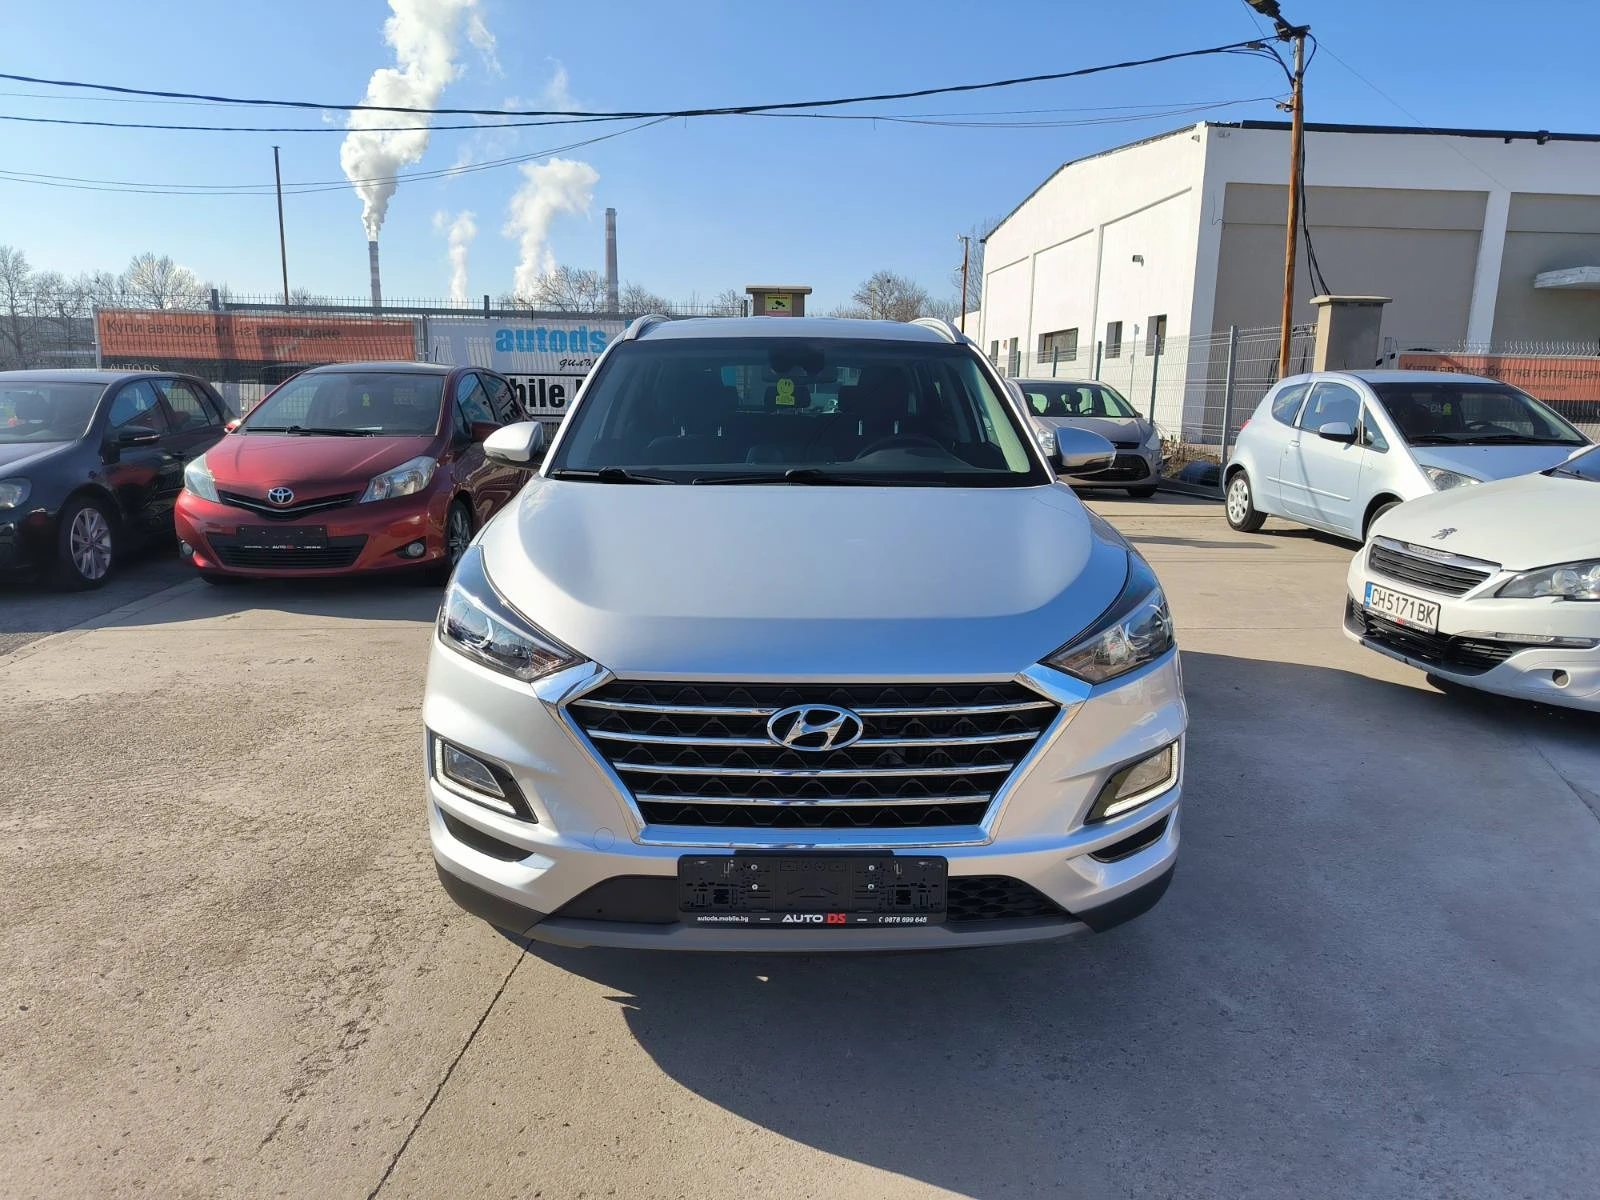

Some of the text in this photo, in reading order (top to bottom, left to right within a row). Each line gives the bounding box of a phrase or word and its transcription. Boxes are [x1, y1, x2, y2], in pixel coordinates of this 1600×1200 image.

[106, 320, 143, 335] Купи
[147, 322, 230, 336] автомобил
[495, 324, 607, 353] autods
[782, 914, 824, 922] AUTO
[827, 913, 847, 924] DS
